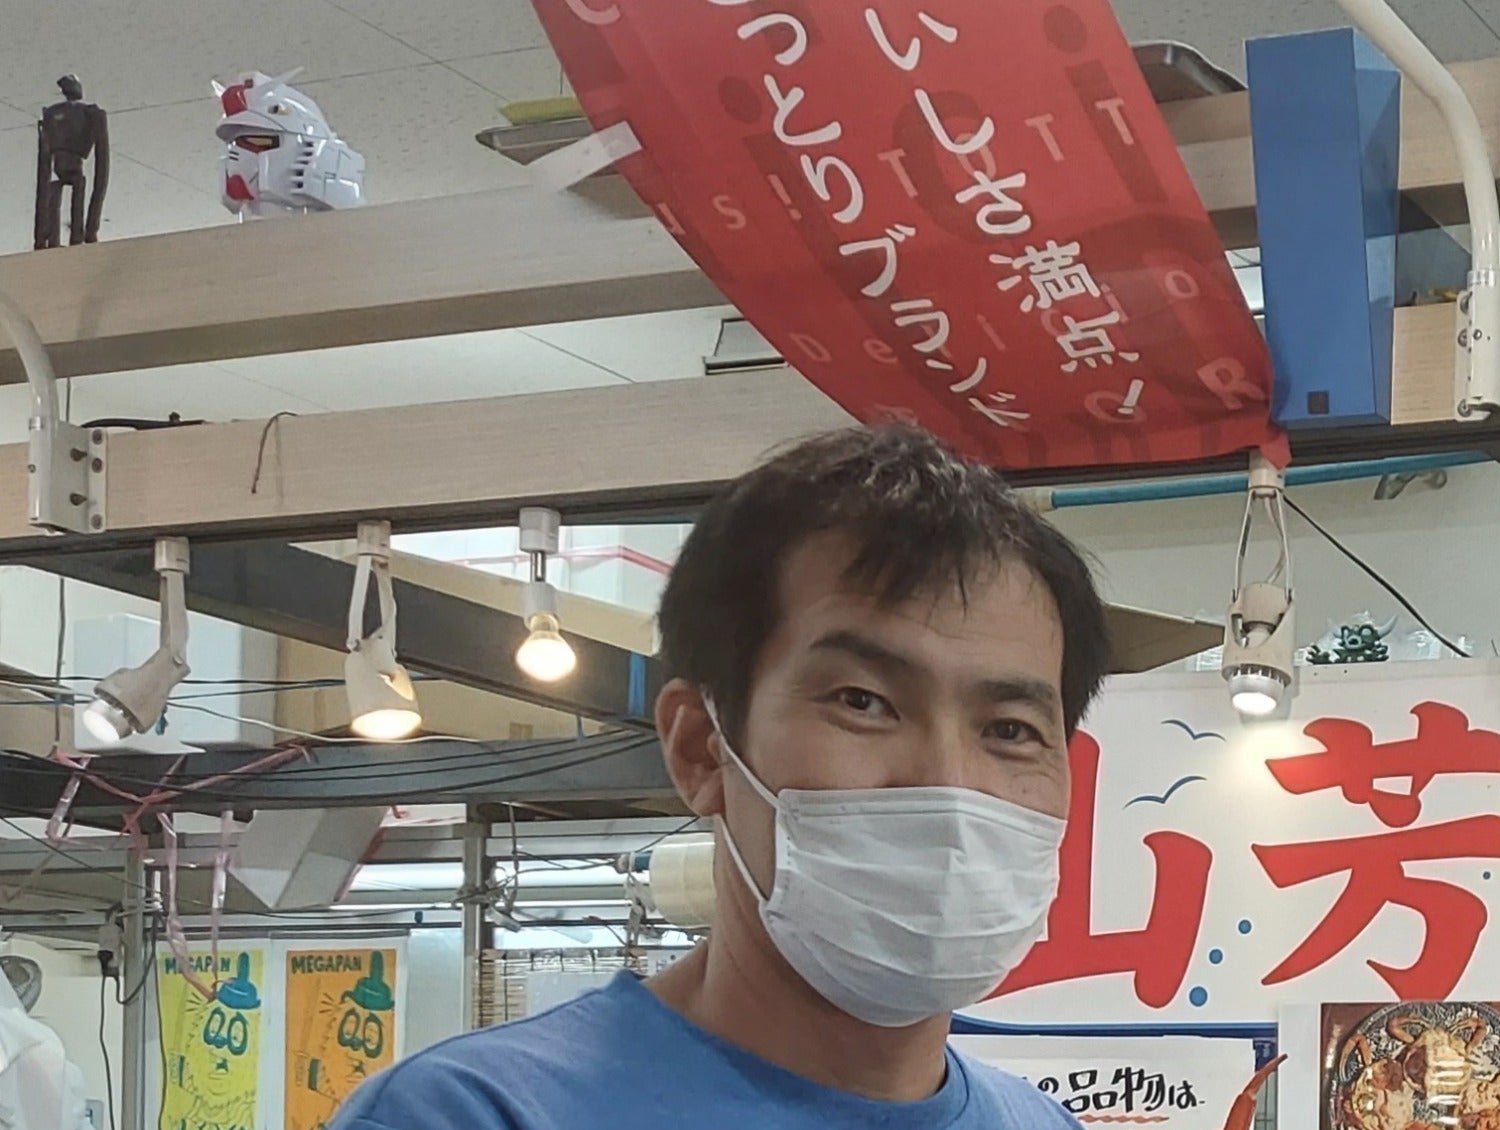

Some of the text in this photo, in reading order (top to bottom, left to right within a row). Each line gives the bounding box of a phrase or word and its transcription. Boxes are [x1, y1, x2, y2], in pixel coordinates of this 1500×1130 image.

[708, 0, 1030, 427] っとりブランド
[291, 953, 362, 974] MEGAPAN
